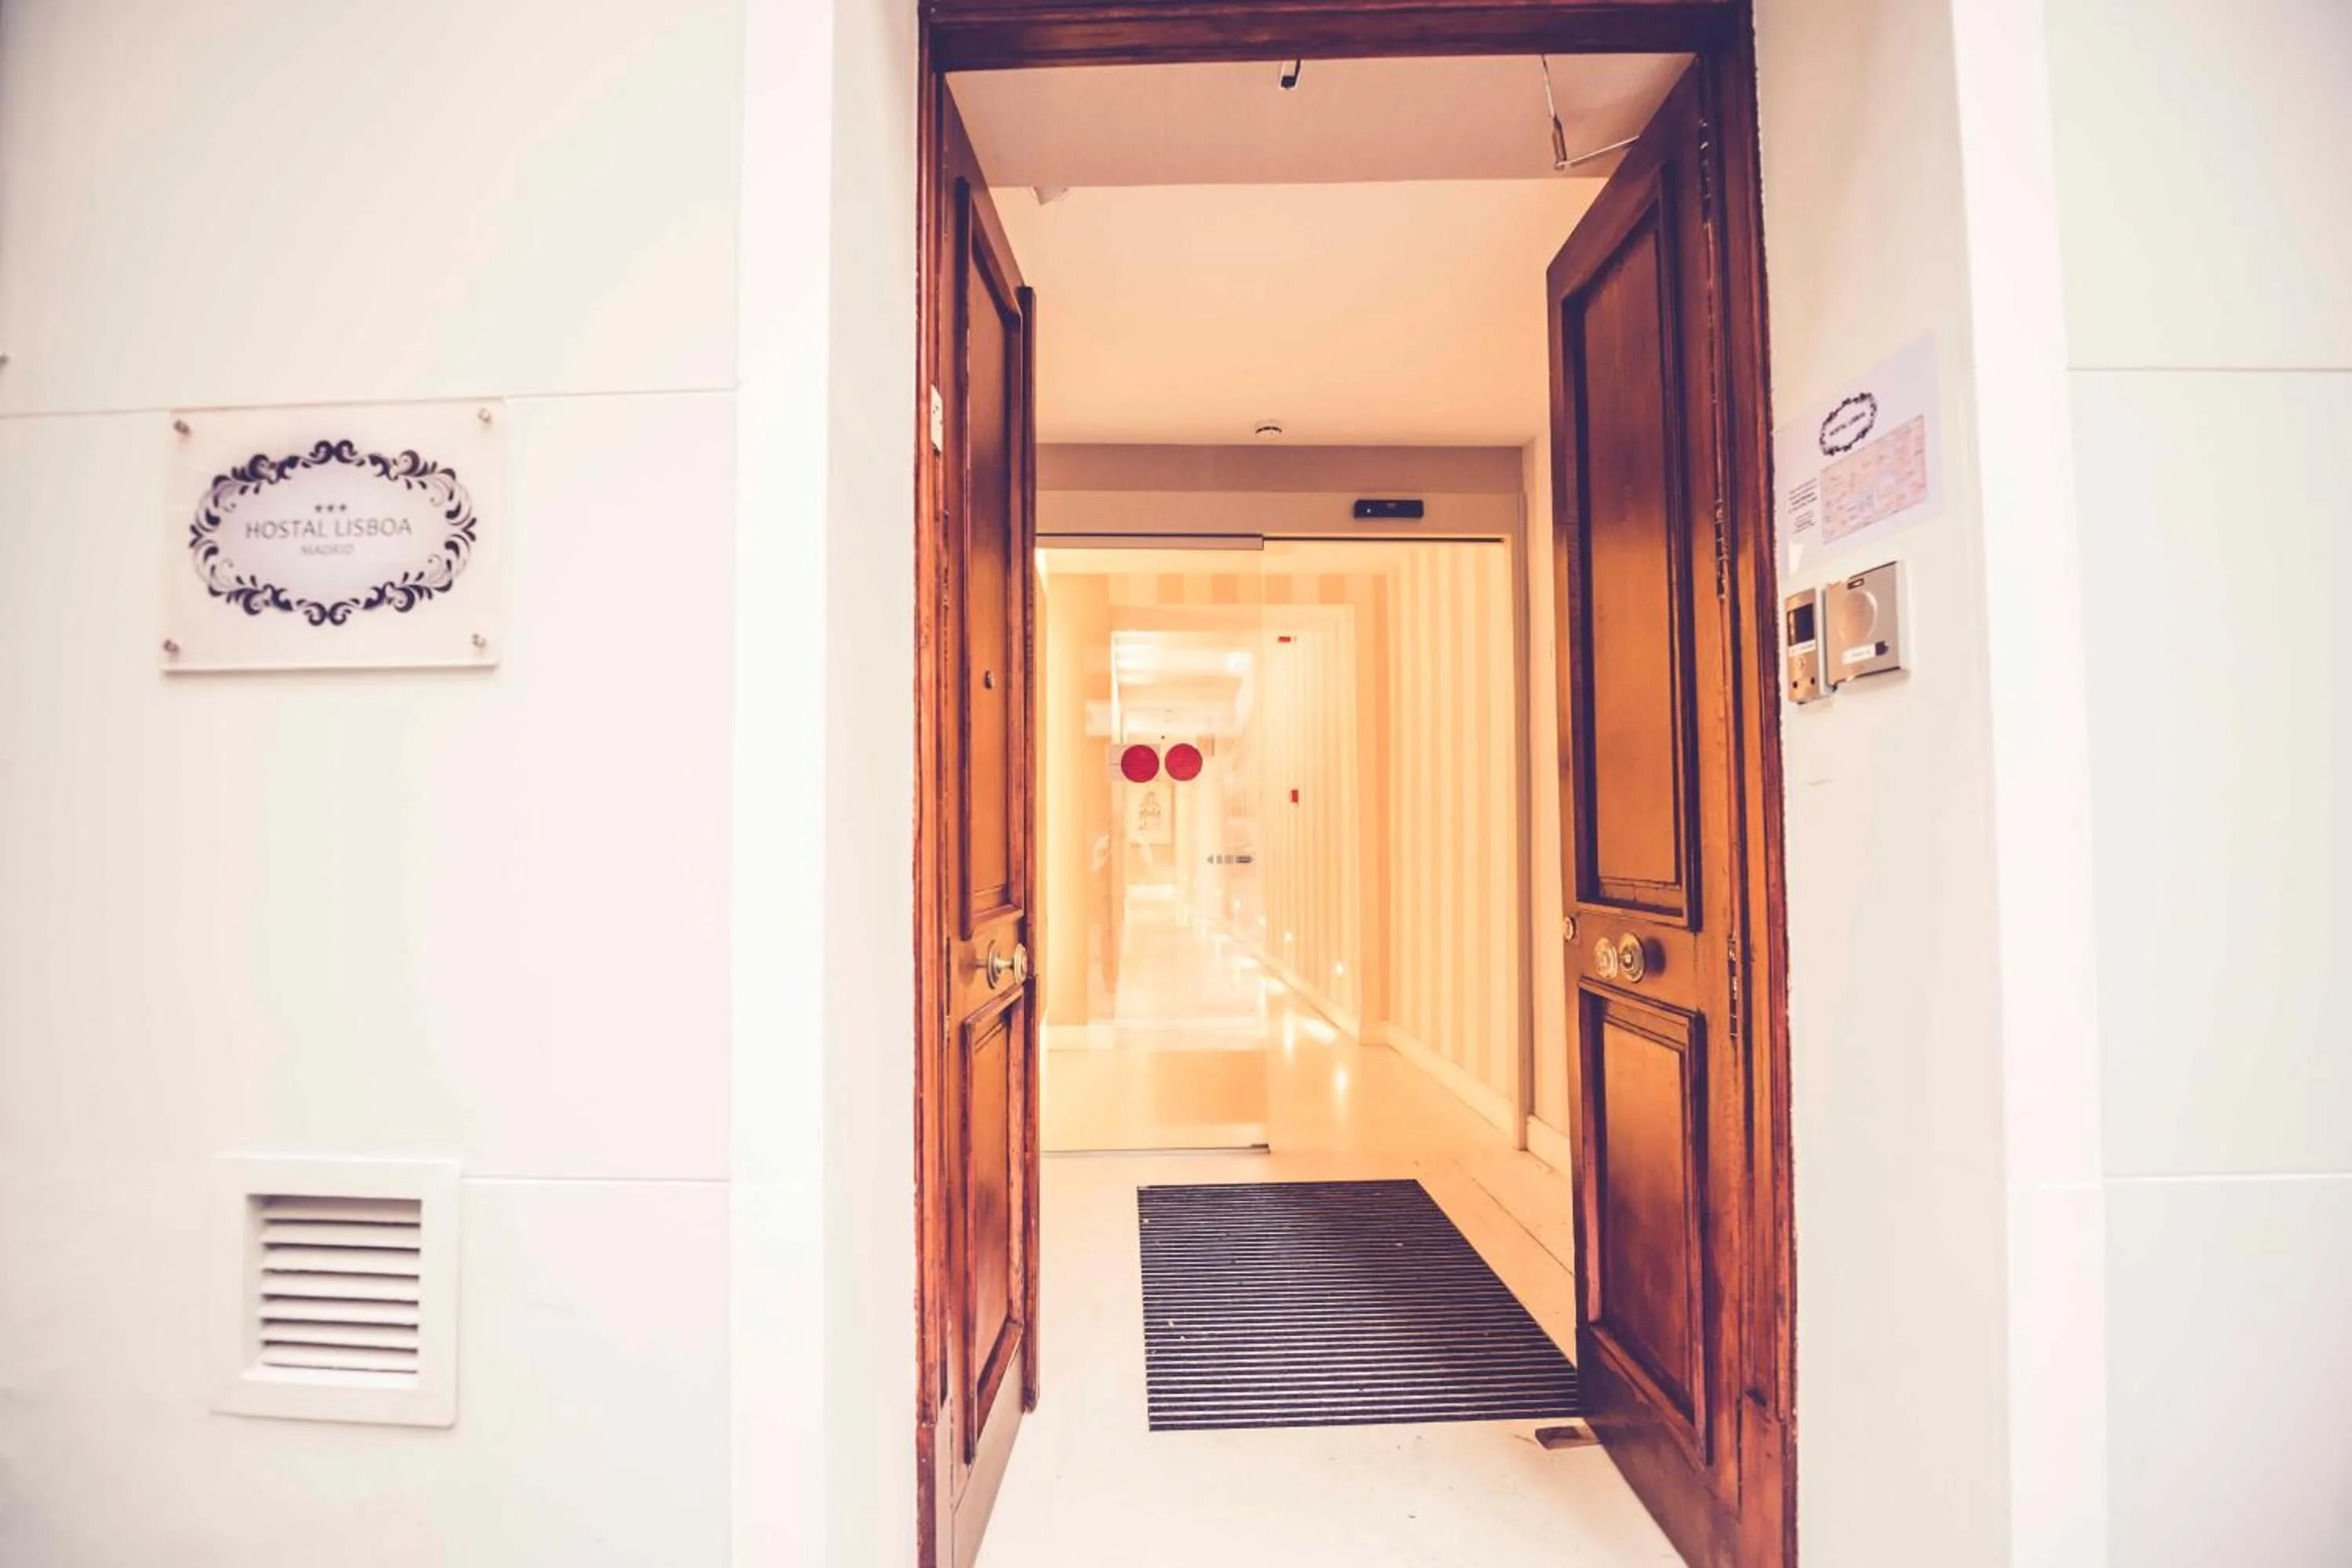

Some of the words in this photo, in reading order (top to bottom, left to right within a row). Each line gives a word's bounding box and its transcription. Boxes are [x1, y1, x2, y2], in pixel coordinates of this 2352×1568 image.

[245, 520, 327, 539] HOSTAL
[334, 517, 412, 538] LISBOA
[301, 543, 354, 555] MADRID
